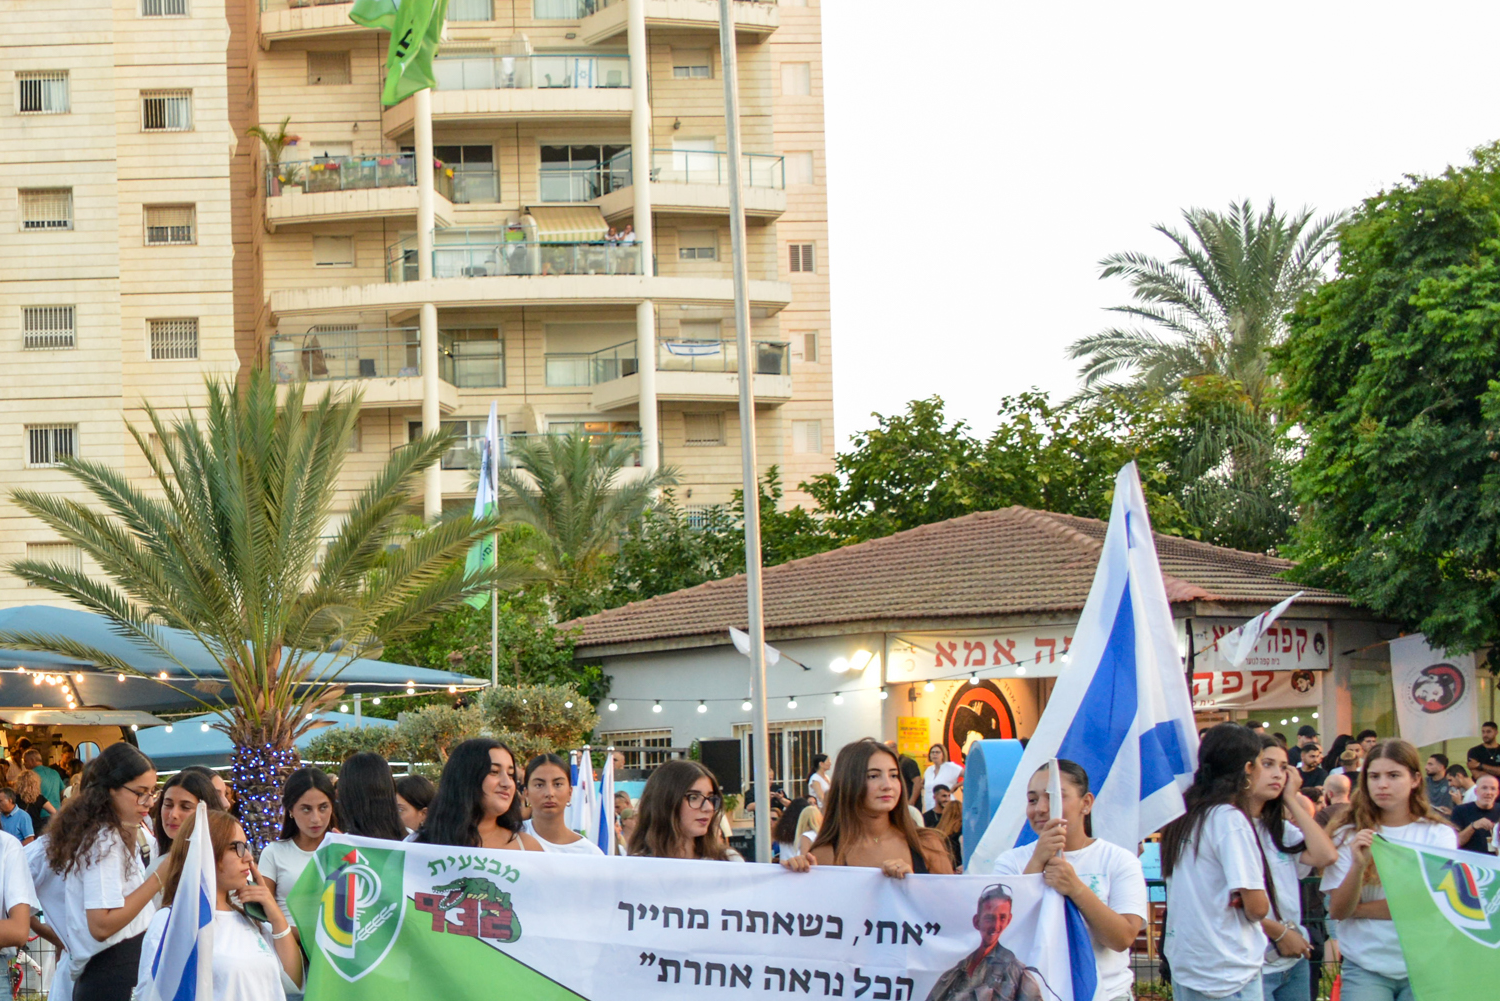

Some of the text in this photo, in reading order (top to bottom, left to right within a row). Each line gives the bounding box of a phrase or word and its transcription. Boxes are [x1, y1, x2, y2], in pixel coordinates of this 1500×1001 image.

[934, 637, 1017, 668] אמא
[1267, 626, 1308, 662] קפה
[1193, 671, 1275, 702] קפה
[427, 854, 521, 884] מבצעית
[414, 891, 513, 941] 932
[618, 901, 709, 931] מחייך
[721, 908, 844, 940] כשאתה
[764, 965, 844, 997] נראה
[853, 967, 914, 1001] הכל
